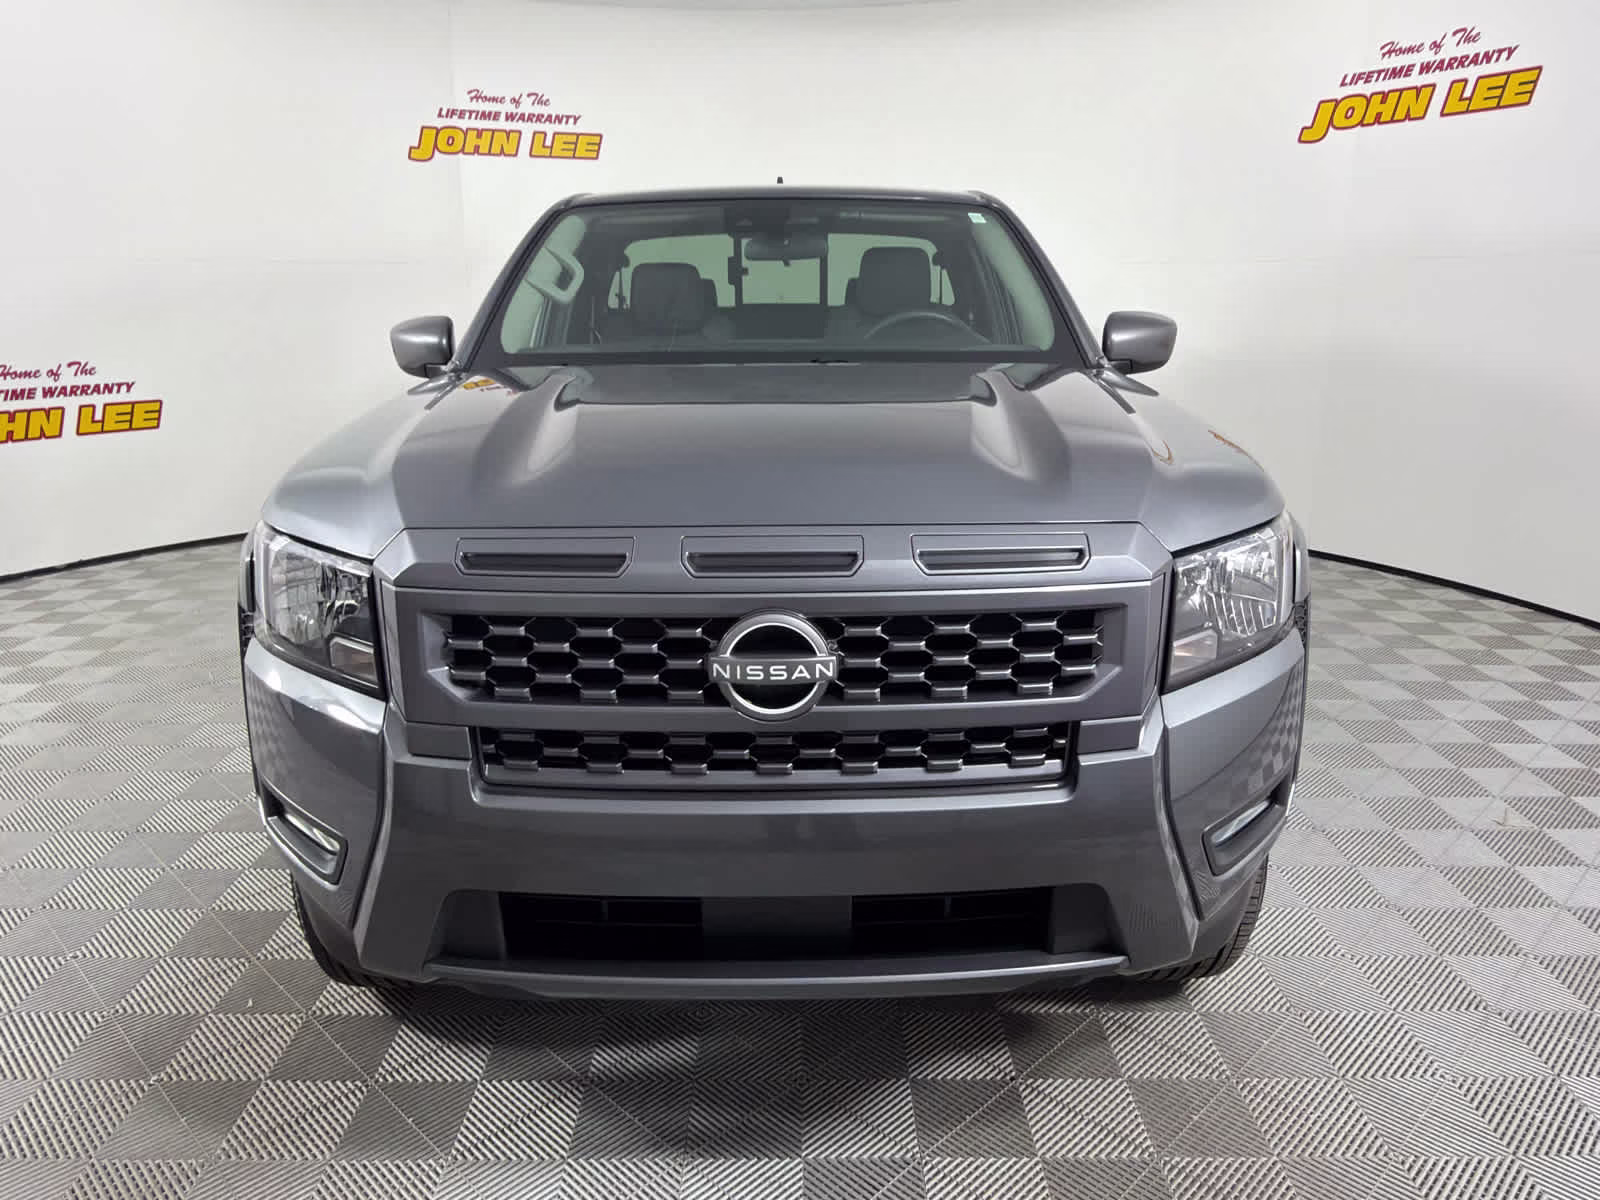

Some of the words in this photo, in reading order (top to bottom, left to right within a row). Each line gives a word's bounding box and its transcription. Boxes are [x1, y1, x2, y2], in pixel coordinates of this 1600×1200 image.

[1380, 40, 1424, 59] Home
[1429, 33, 1446, 52] of
[1452, 26, 1481, 46] The
[1340, 63, 1415, 87] LIFETIME
[1419, 44, 1520, 75] WARRANTY
[467, 89, 505, 104] Home
[510, 94, 522, 108] of
[527, 93, 550, 106] The
[1298, 83, 1436, 143] JOHN
[1440, 66, 1543, 117] LEE
[437, 107, 502, 121] LIFETIME
[504, 112, 581, 125] WARRANTY
[408, 126, 522, 162] JOHN
[529, 131, 602, 160] LEE
[0, 364, 41, 380] Home
[46, 364, 61, 382] of
[67, 361, 96, 376] The
[42, 382, 136, 398] WARRANTY
[76, 400, 163, 436] LEE
[712, 662, 833, 680] NISSAN
